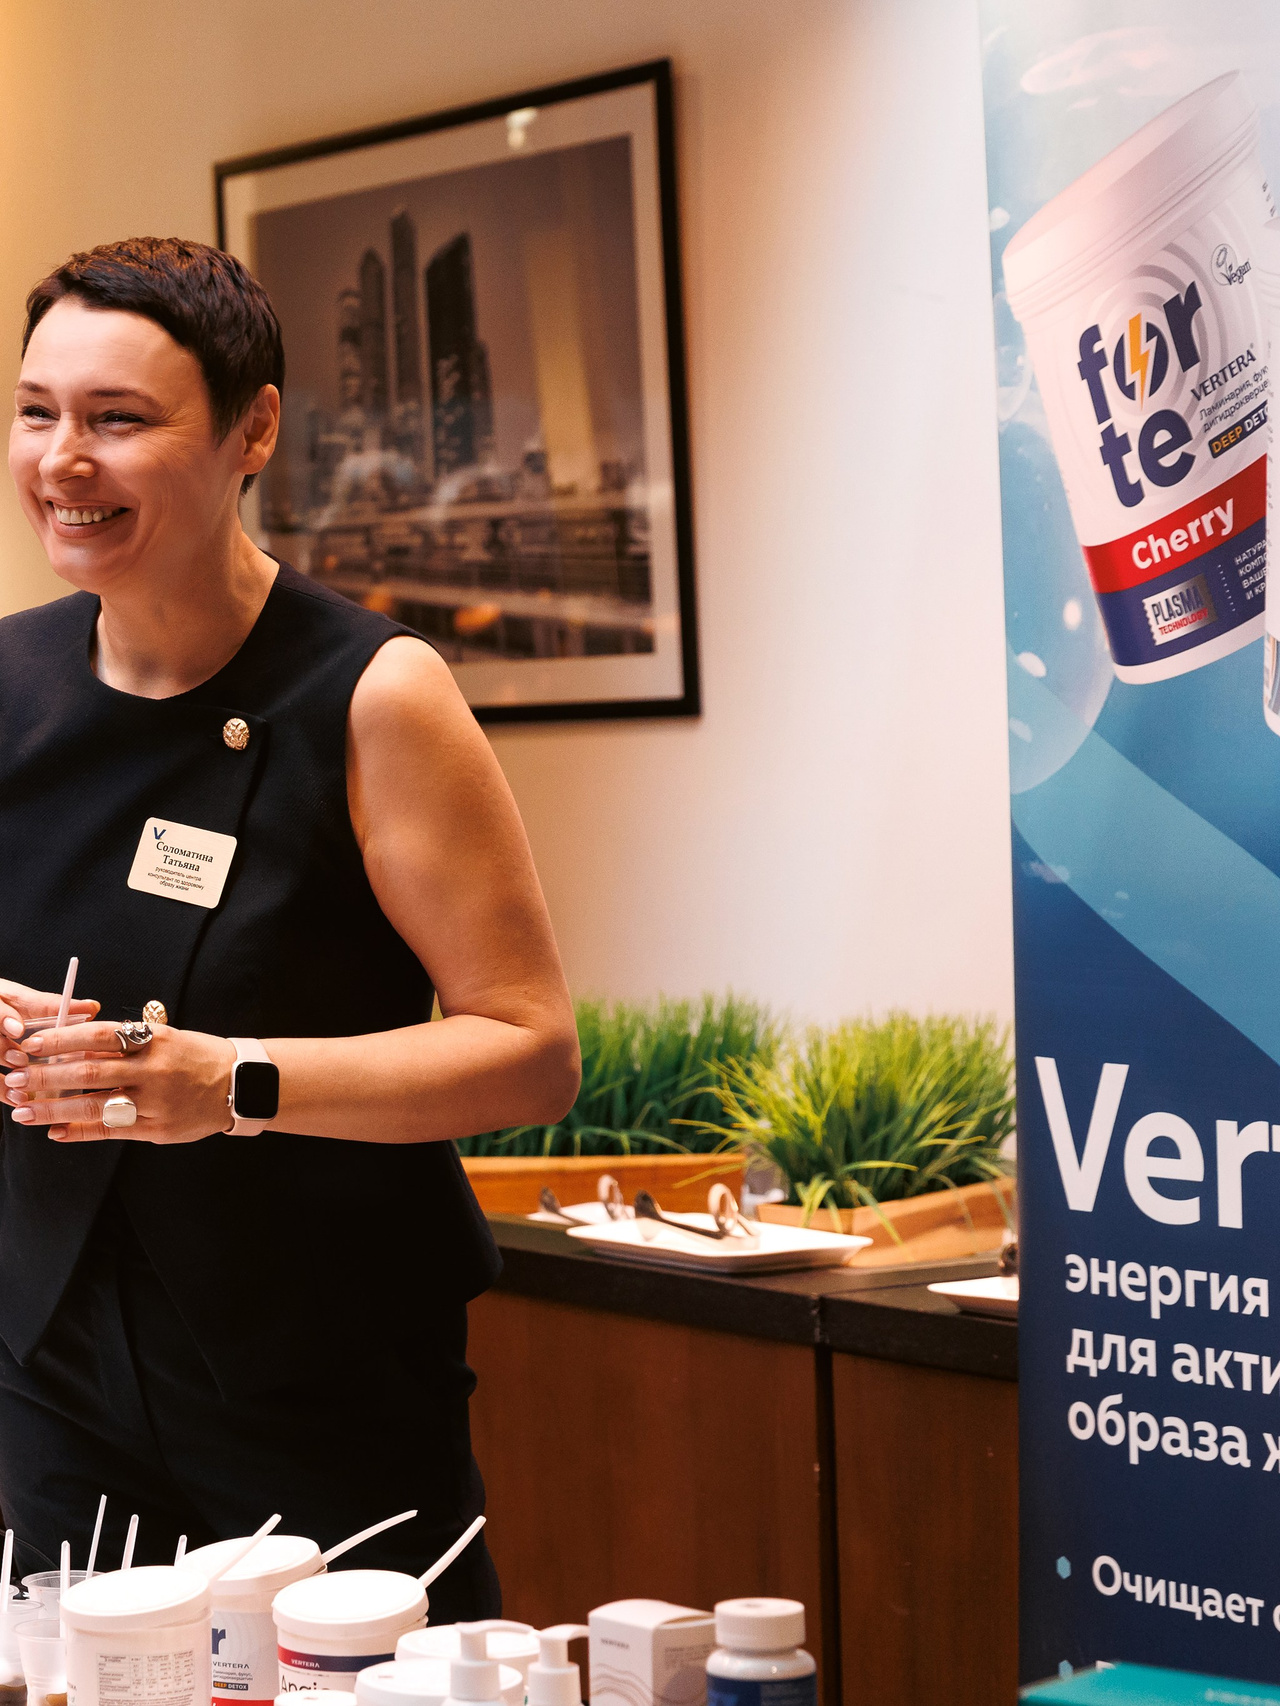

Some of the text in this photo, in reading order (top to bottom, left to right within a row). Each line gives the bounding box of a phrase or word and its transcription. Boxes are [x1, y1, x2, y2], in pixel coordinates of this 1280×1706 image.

[1190, 349, 1257, 402] VERTERA
[1098, 408, 1196, 508] te
[1211, 425, 1243, 454] DEEP
[1131, 498, 1235, 570] Cherry
[1150, 585, 1206, 626] PLASMA
[1158, 608, 1209, 636] TECHNOLOGY
[156, 841, 214, 863] Соломатина
[163, 854, 200, 872] Татьяна
[1034, 1055, 1280, 1230] Ver
[1065, 1253, 1270, 1320] энергия
[1066, 1328, 1157, 1378] для
[1067, 1393, 1252, 1465] образа
[1091, 1555, 1264, 1627] Очищает
[212, 1661, 250, 1669] VERTERA
[290, 1658, 321, 1669] VERTERA
